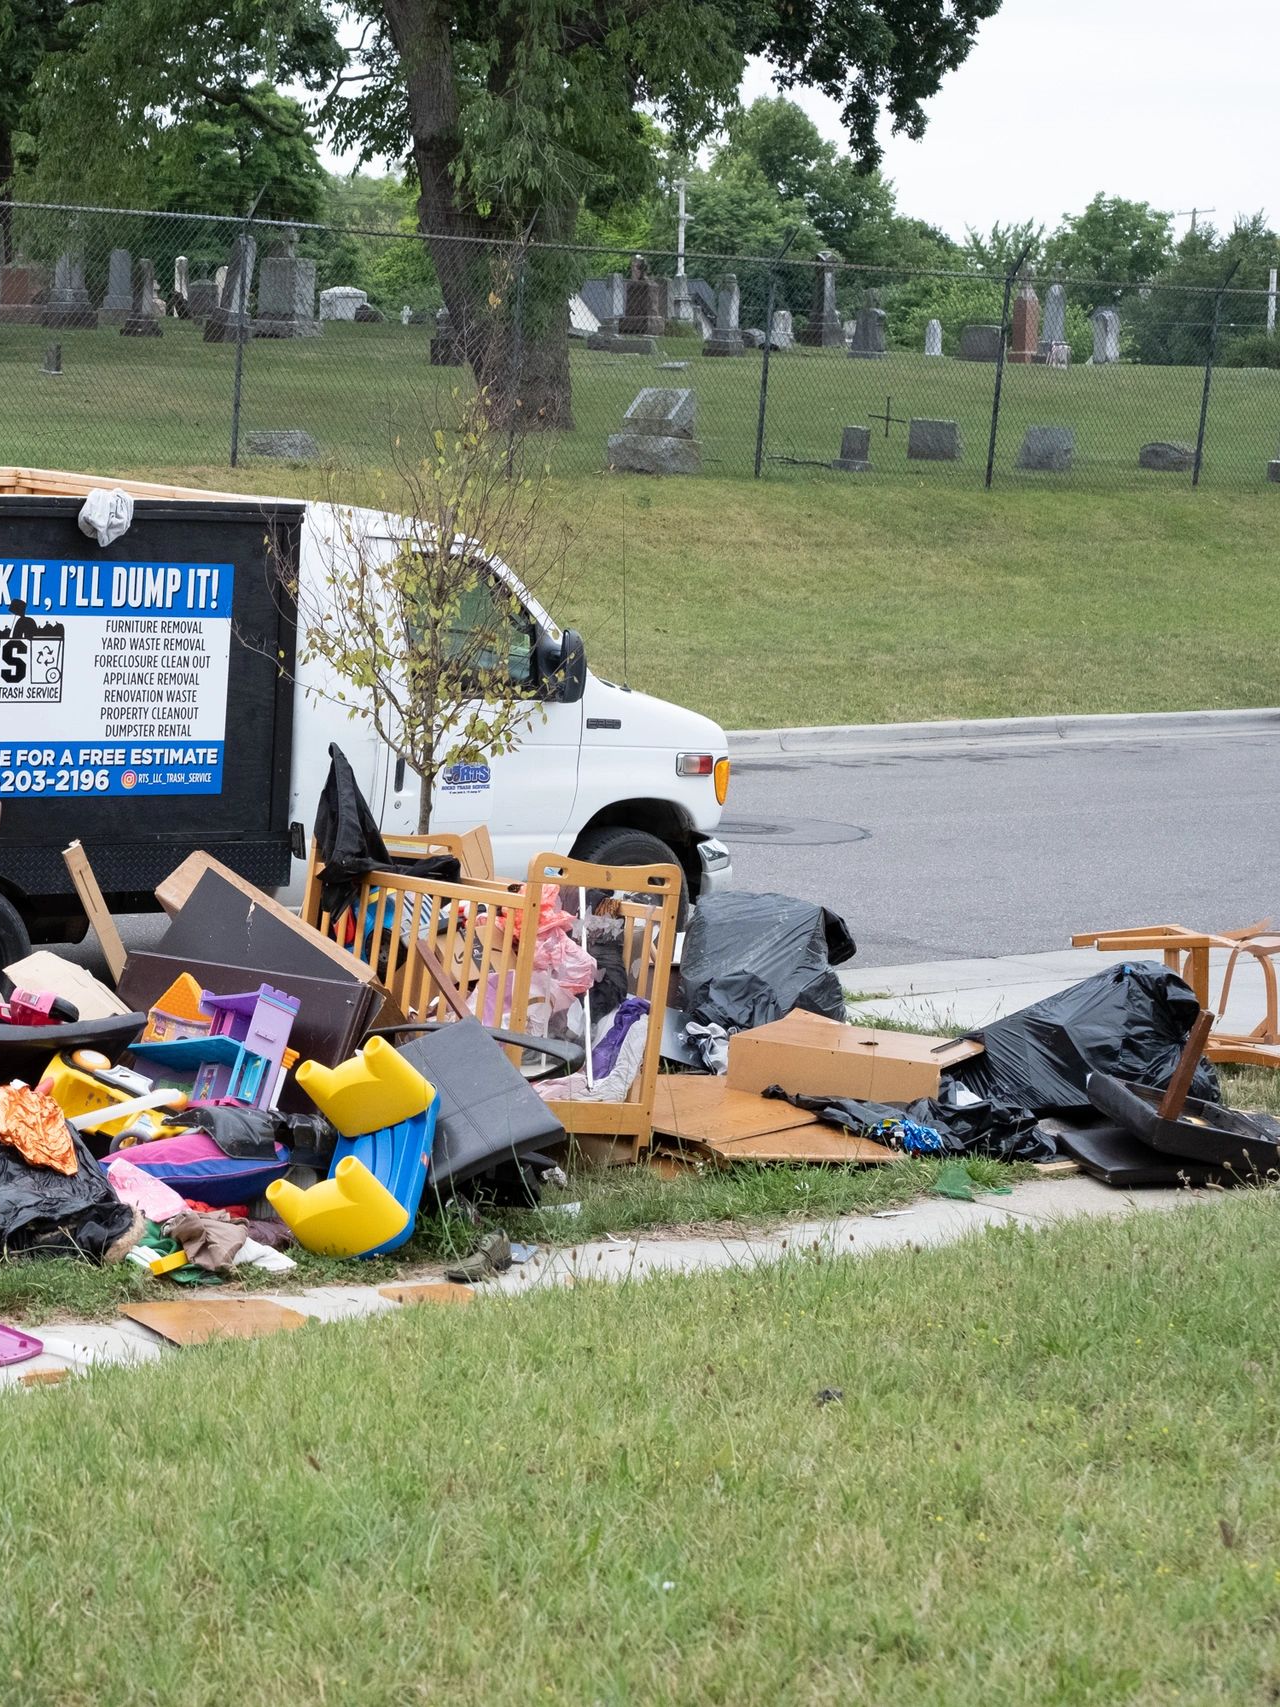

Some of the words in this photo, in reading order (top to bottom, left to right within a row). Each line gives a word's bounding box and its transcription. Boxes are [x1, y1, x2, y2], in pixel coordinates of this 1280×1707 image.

[20, 564, 52, 610] IT,
[59, 565, 104, 607] I’LL
[111, 566, 182, 608] DUMP
[186, 568, 219, 609] IT!
[106, 620, 158, 633] FURNITURE
[161, 620, 202, 634] REMOVAL
[102, 637, 126, 650] YARD
[130, 637, 161, 650] WASTE
[163, 638, 205, 651] REMOVAL
[94, 655, 158, 668] FORECLOSURE
[161, 655, 189, 668] CLEAN
[192, 655, 211, 668] OUT
[103, 672, 154, 685] APPLIANCE
[157, 672, 199, 685] REMOVAL
[26, 687, 59, 698] SERVICE
[104, 690, 163, 702] RENOVATION
[166, 690, 197, 702] WASTE
[100, 707, 149, 719] PROPERTY
[151, 707, 199, 719] CLEANOUT
[105, 724, 155, 737] DUMPSTER
[157, 724, 191, 737] RENTAL
[16, 750, 55, 766] FOR
[59, 750, 73, 765] A
[79, 749, 125, 765] FREE
[130, 748, 218, 765] ESTIMATE
[138, 772, 212, 785] RTS_LLC_TRASH_SERVICE
